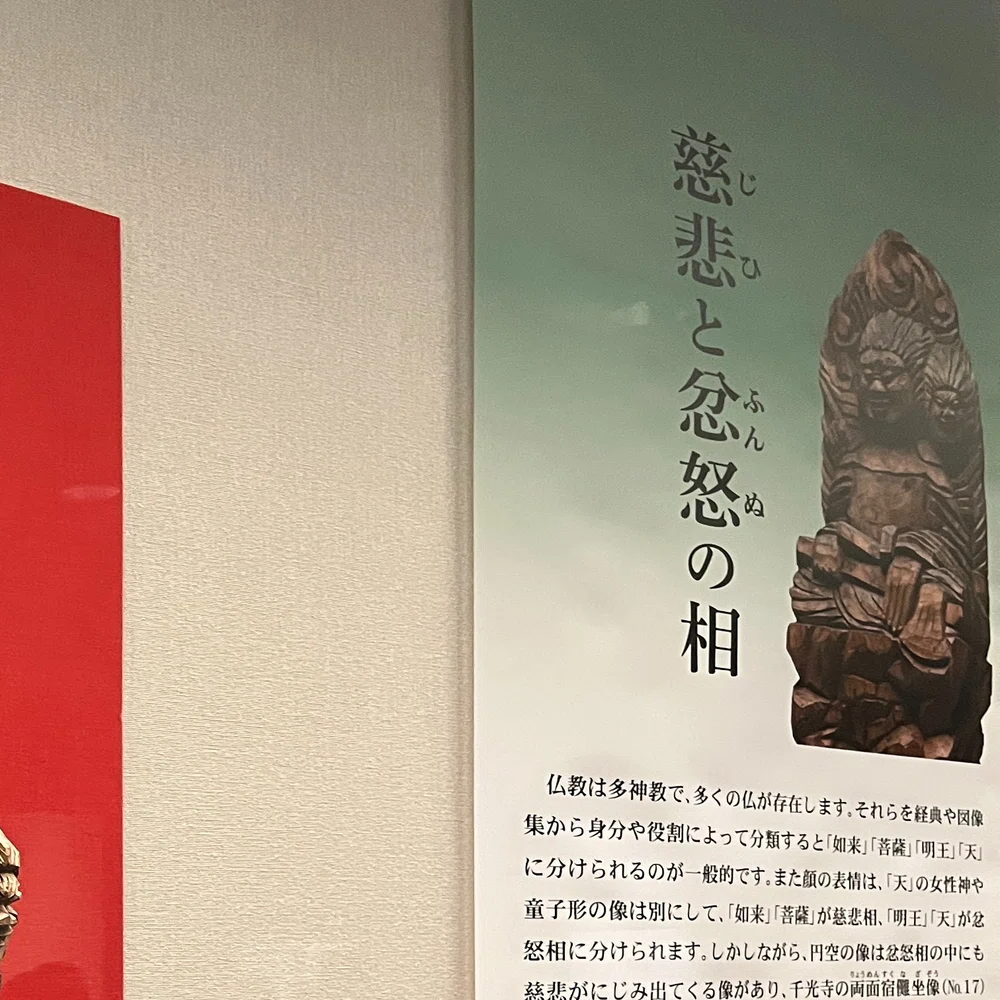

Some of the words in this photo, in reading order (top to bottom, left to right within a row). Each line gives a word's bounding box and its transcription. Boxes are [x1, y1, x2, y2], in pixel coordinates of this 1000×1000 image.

[737, 170, 757, 197] じ
[741, 255, 761, 281] ひ
[671, 124, 741, 677] 慈悲と忿怒の相
[743, 491, 765, 519] ぬ
